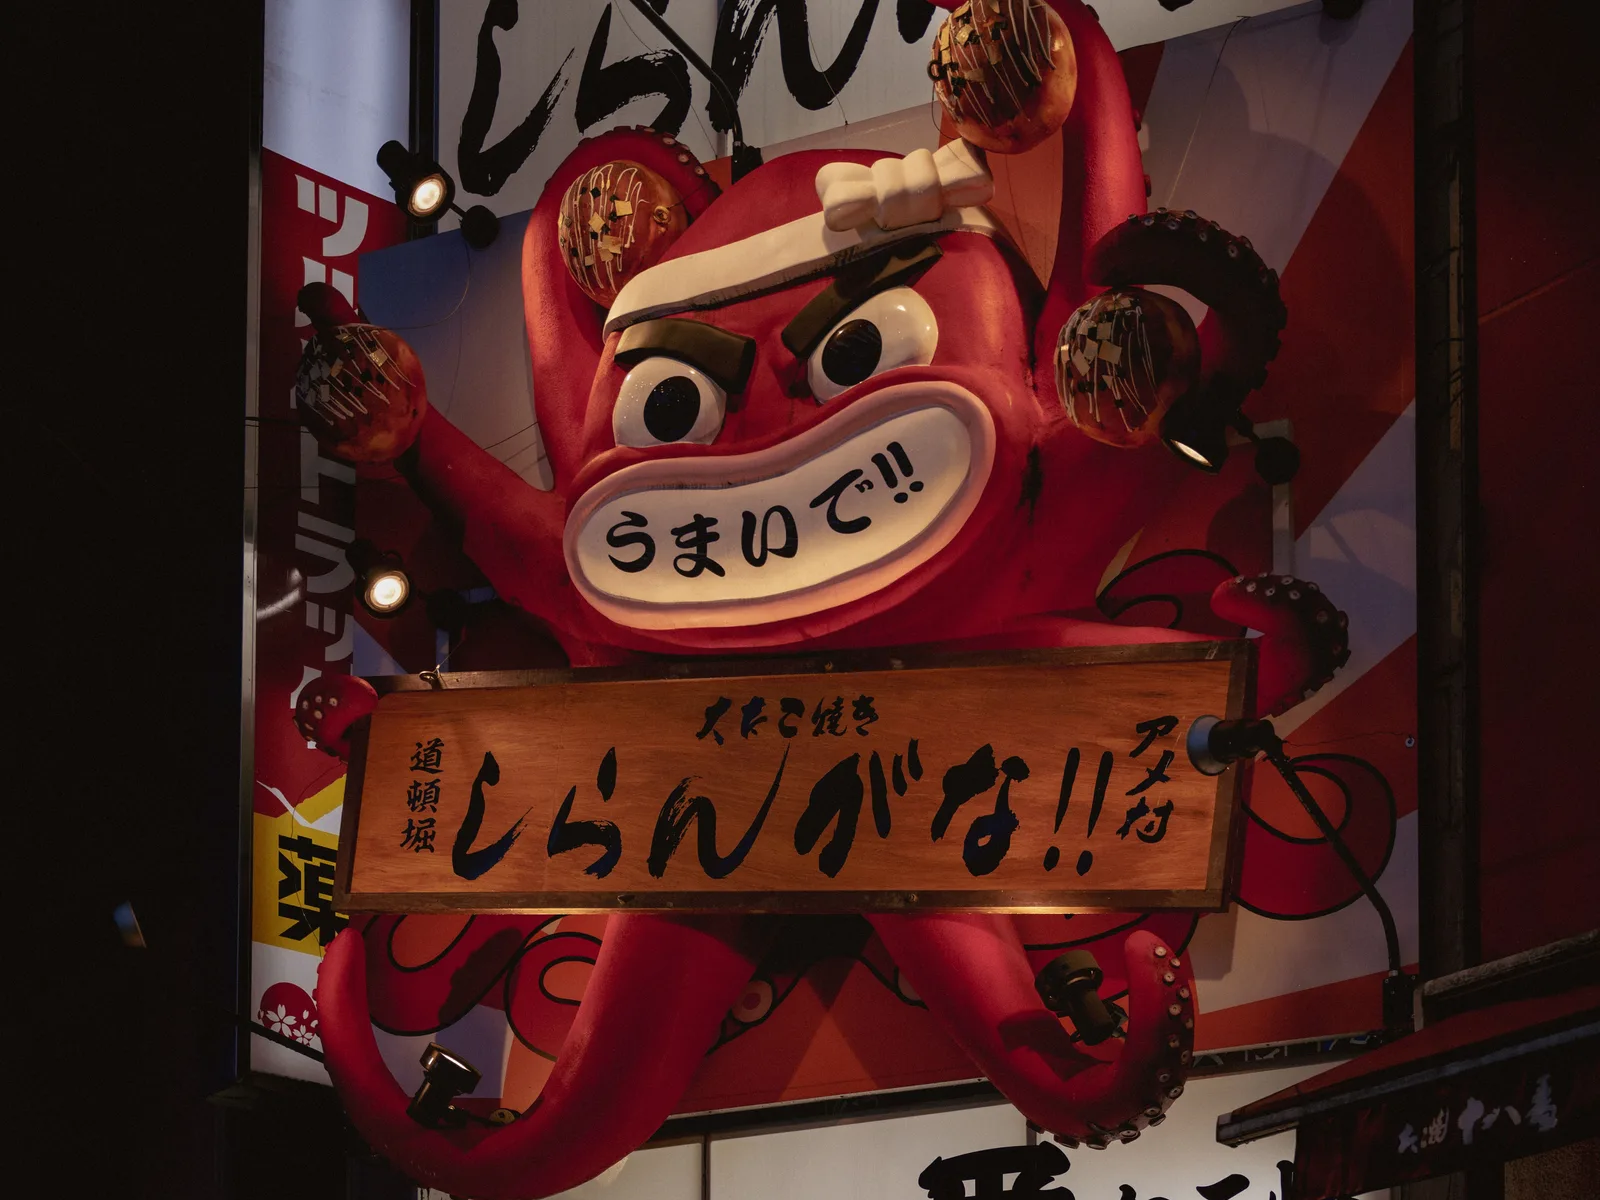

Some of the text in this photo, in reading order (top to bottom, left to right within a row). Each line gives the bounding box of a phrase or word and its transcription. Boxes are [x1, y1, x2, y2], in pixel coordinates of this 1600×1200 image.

[459, 0, 937, 195] しらん
[606, 441, 923, 577] うまいで!!
[697, 694, 880, 744] 大たこ焼き
[1118, 715, 1180, 842] アメ村
[400, 738, 445, 853] 道頓堀
[453, 736, 1113, 880] しらんがな!!
